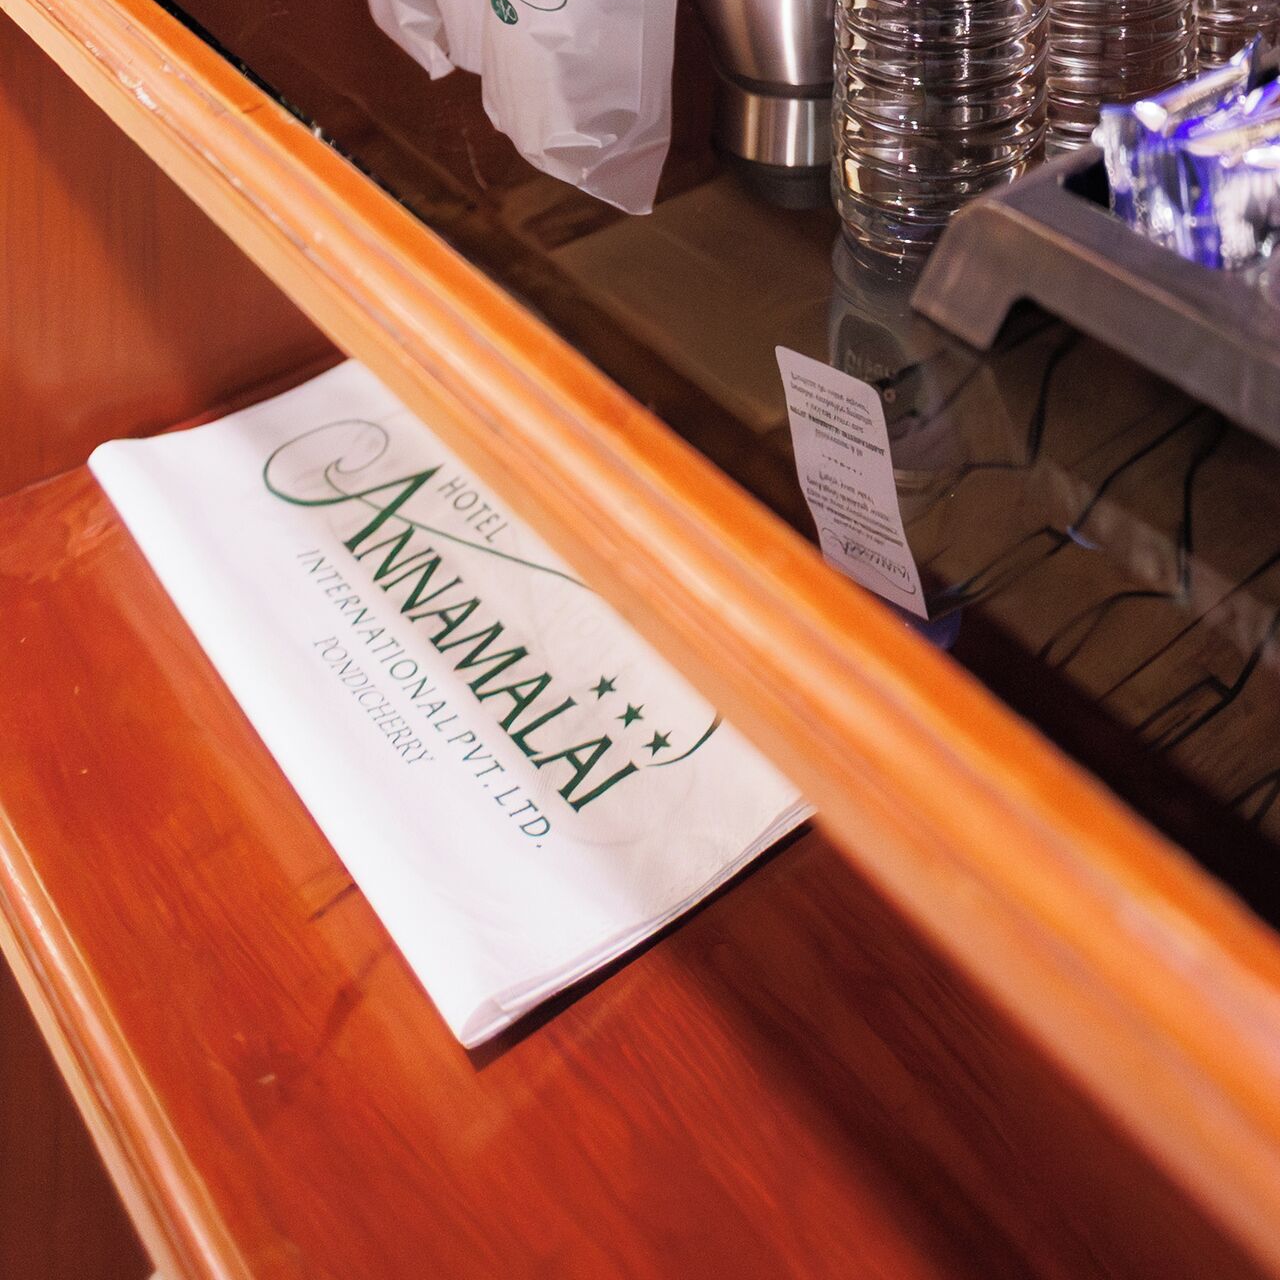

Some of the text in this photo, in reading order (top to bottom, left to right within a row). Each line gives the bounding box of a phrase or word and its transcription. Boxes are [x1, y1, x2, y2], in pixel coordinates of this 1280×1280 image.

[437, 474, 510, 545] HOTEL
[264, 455, 640, 814] ANNAMALAI
[296, 548, 552, 849] INTERNATIONAL PVT. LTD.
[312, 634, 437, 767] PONDICHERRY
